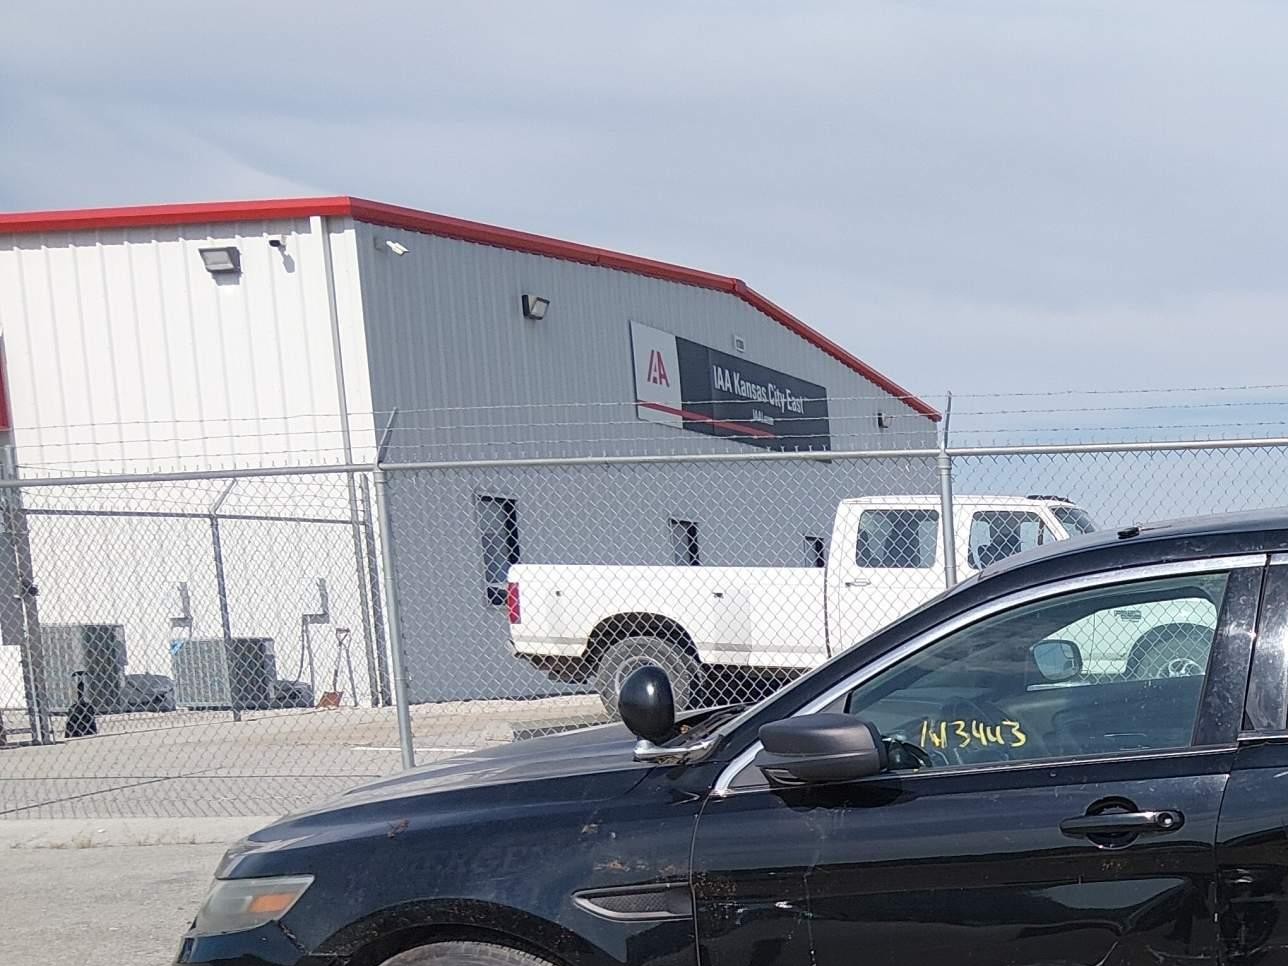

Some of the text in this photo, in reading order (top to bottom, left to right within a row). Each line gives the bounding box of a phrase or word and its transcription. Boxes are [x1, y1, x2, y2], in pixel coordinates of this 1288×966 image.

[713, 365, 805, 415] IAA Kansas City East
